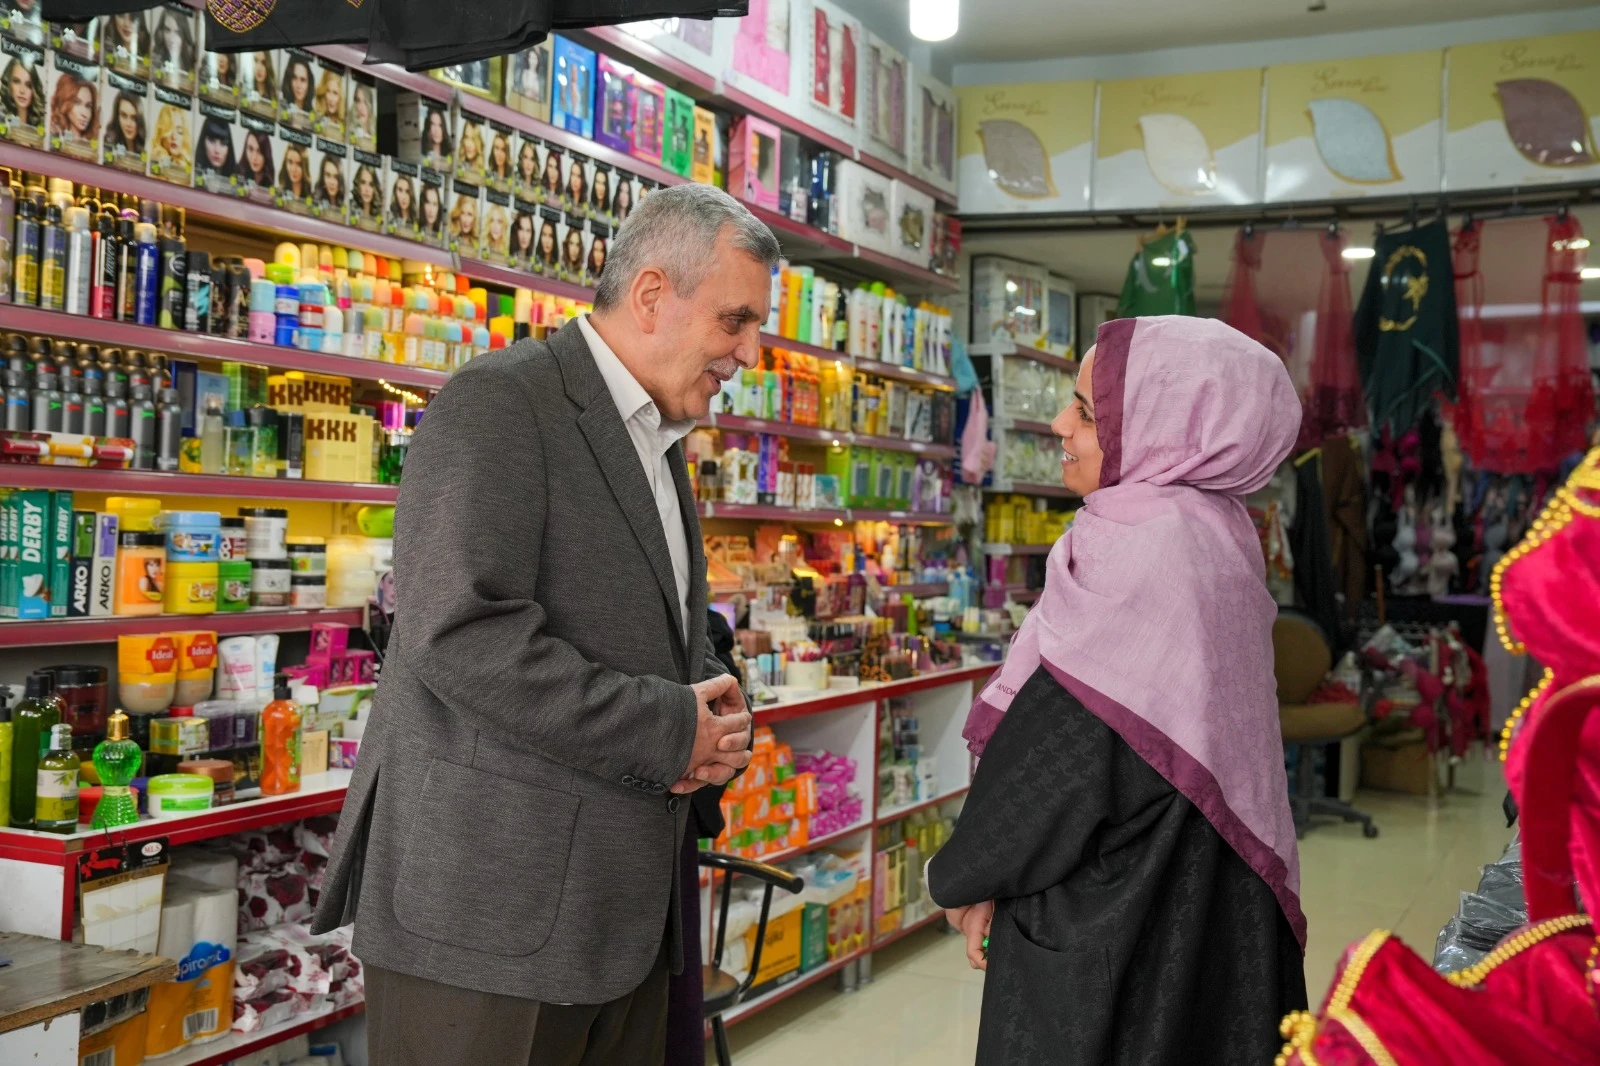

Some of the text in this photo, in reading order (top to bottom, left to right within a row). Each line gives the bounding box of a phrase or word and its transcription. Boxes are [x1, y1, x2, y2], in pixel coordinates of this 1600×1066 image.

[9, 506, 18, 541] DERBY
[22, 499, 42, 563] DERBY
[56, 507, 69, 542] DERBY
[73, 566, 88, 613] ARKO
[99, 565, 111, 609] ARKO
[151, 649, 173, 660] Ideal
[191, 646, 213, 657] Ideal
